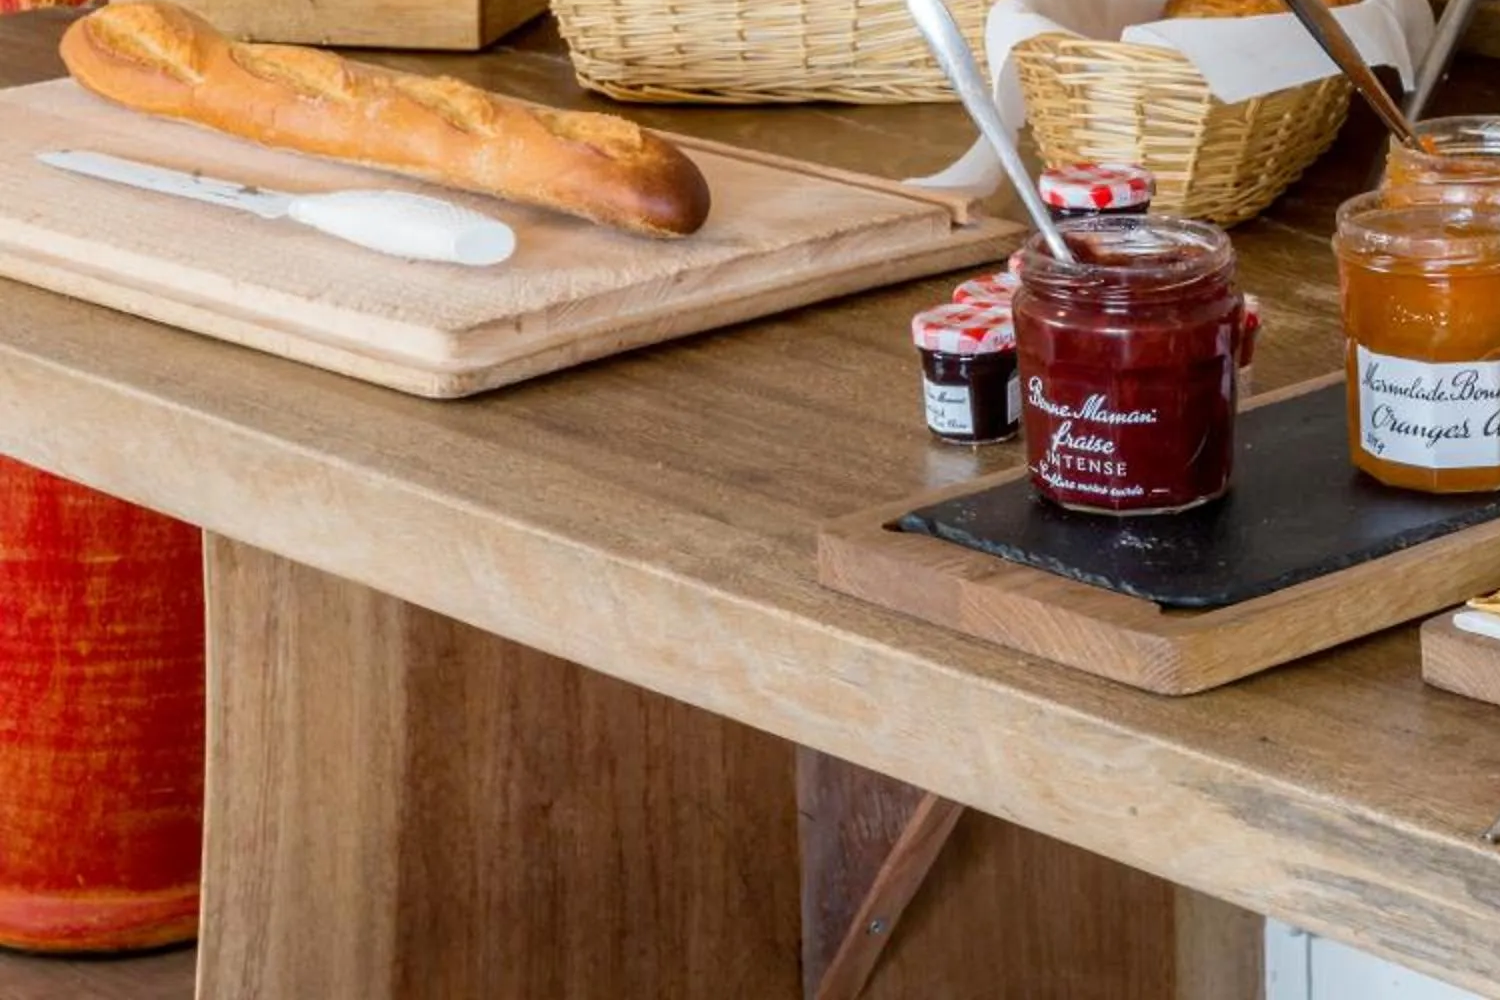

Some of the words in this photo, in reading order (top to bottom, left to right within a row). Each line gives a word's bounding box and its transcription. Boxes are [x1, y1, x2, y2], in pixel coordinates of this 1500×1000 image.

[1073, 393, 1153, 424] Maman
[1051, 420, 1116, 454] fraise
[1371, 403, 1472, 449] Oranges
[1046, 450, 1128, 478] INTENSE
